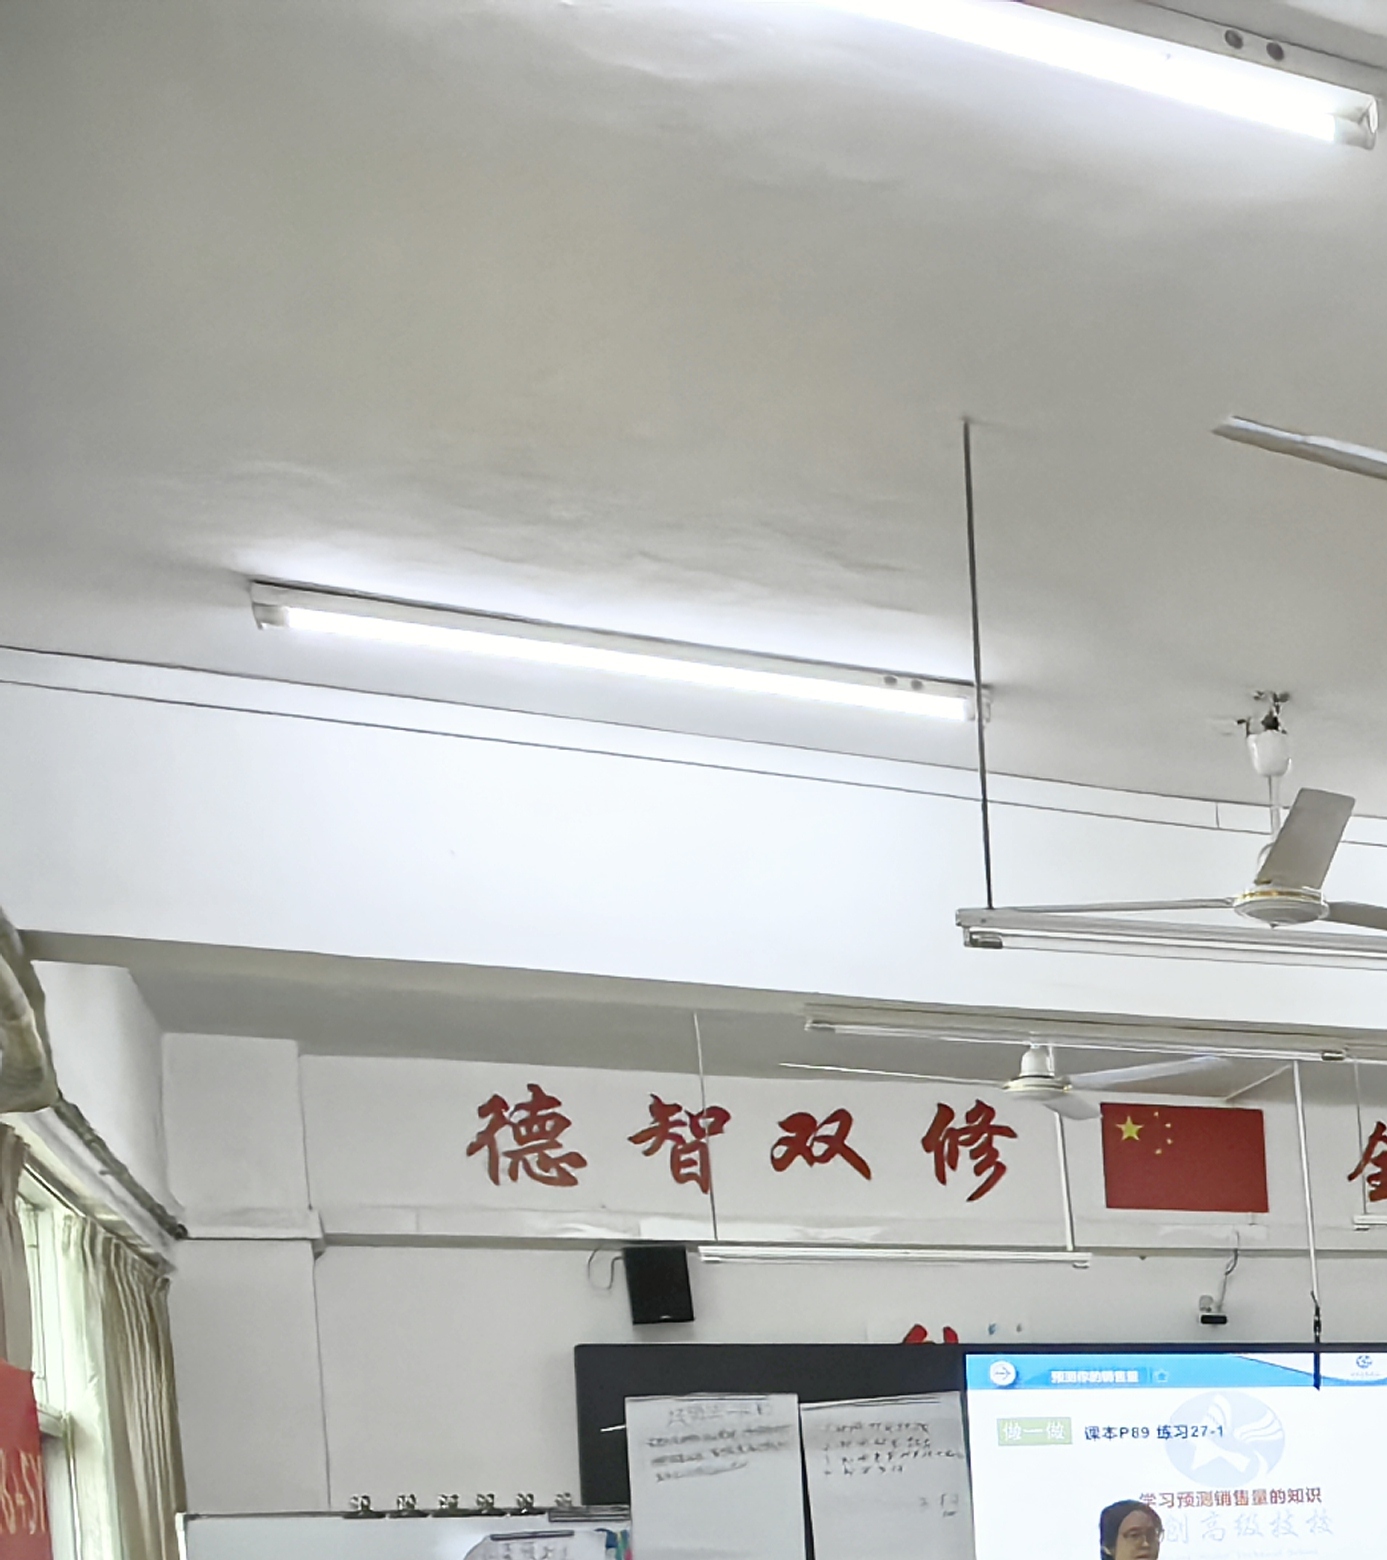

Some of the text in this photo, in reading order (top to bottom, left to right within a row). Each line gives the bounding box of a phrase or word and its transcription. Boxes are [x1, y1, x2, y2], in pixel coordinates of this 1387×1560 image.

[466, 1083, 1018, 1203] 德智双修
[1002, 1420, 1066, 1442] 做一做
[1138, 1486, 1323, 1509] 学习预测销售量的知识
